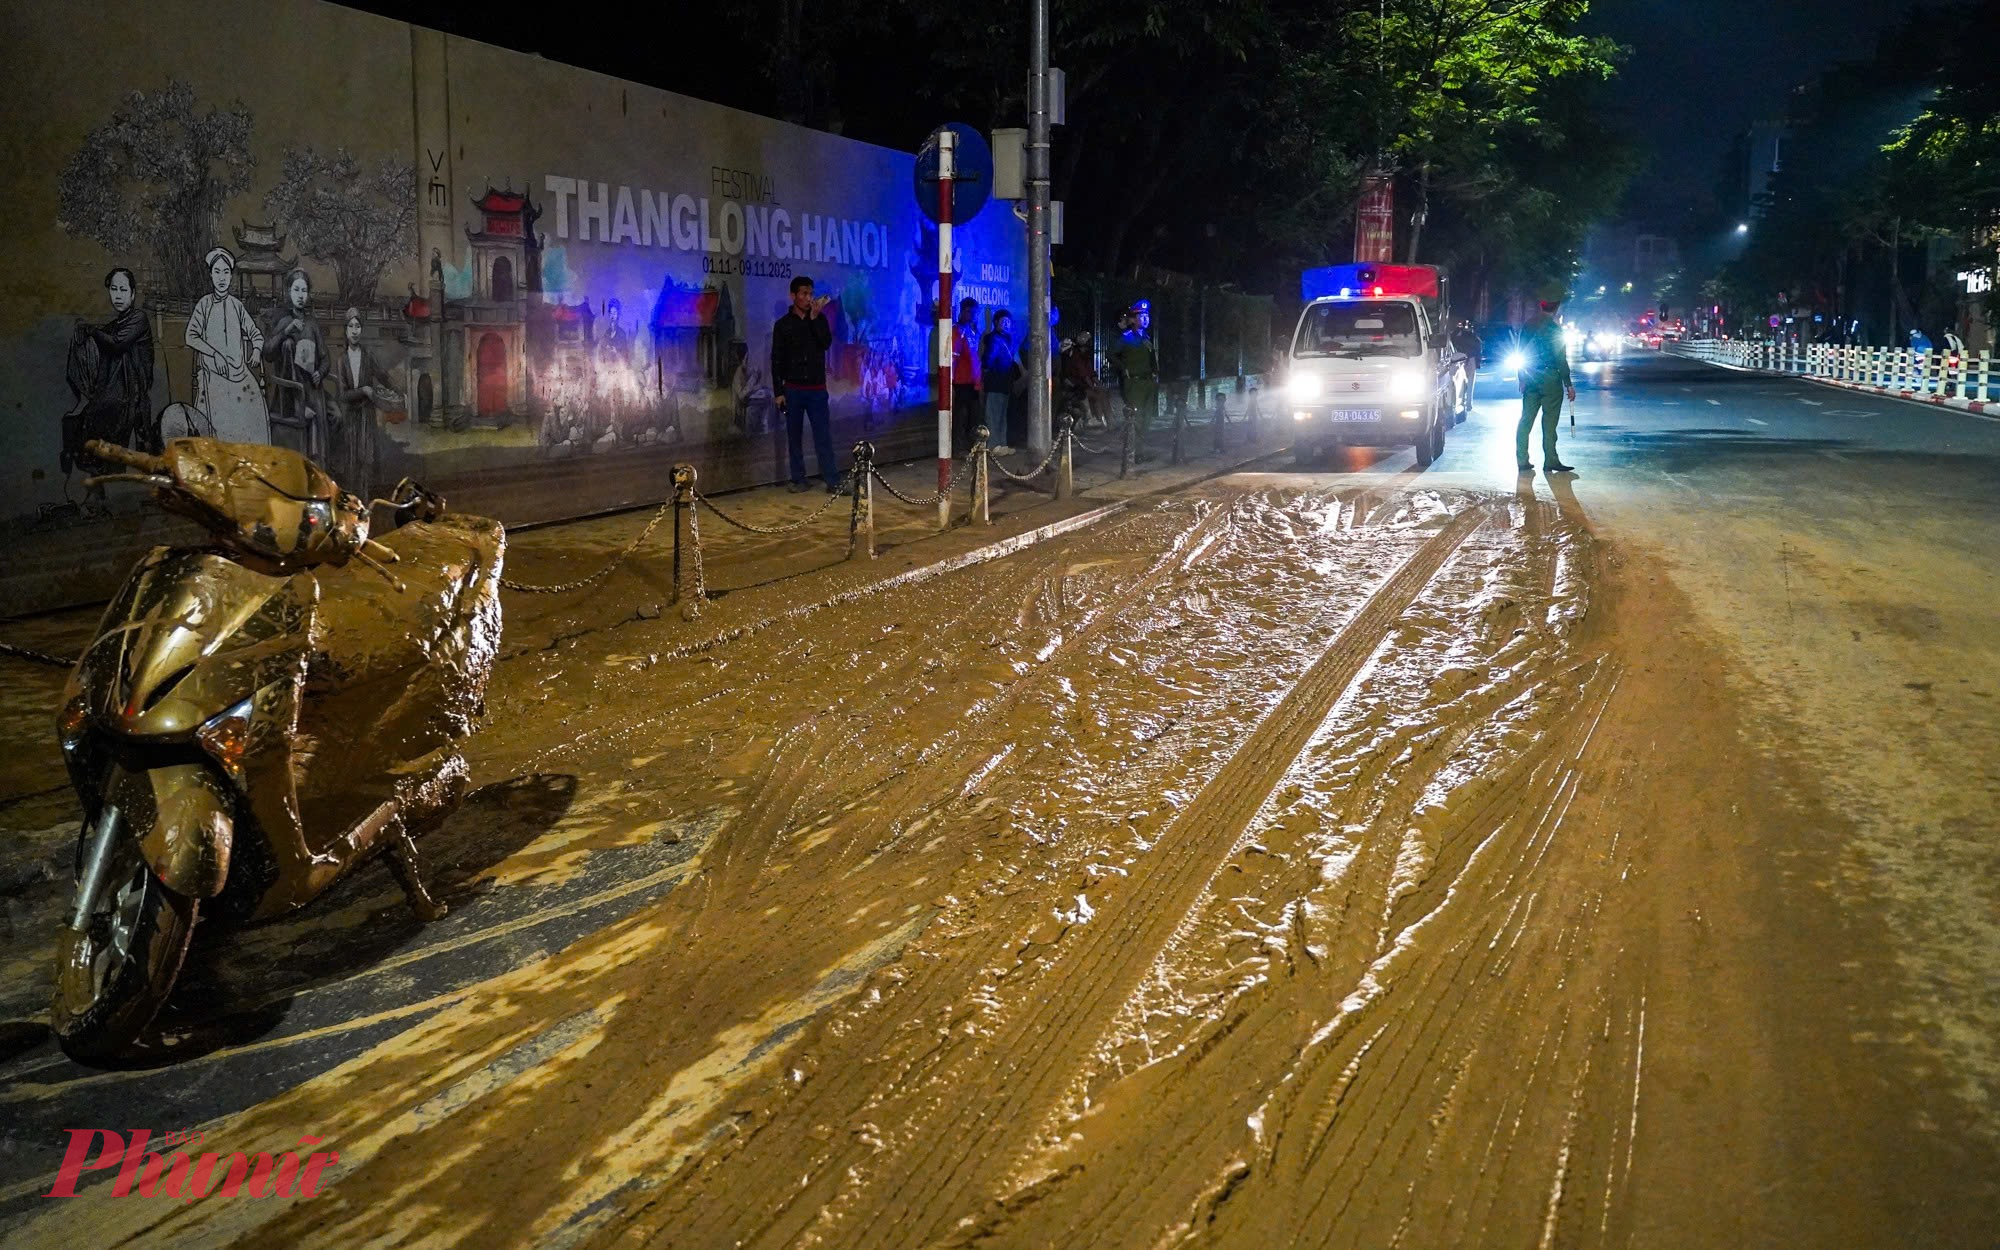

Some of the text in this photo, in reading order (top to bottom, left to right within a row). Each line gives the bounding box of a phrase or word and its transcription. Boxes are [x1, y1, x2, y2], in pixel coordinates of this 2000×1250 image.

[711, 166, 780, 205] FESTIVAL
[545, 174, 889, 269] THANGLONG.HANOI
[702, 256, 732, 275] 01.11
[739, 259, 791, 279] 09.11.2025
[959, 285, 1010, 306] THANGLONG
